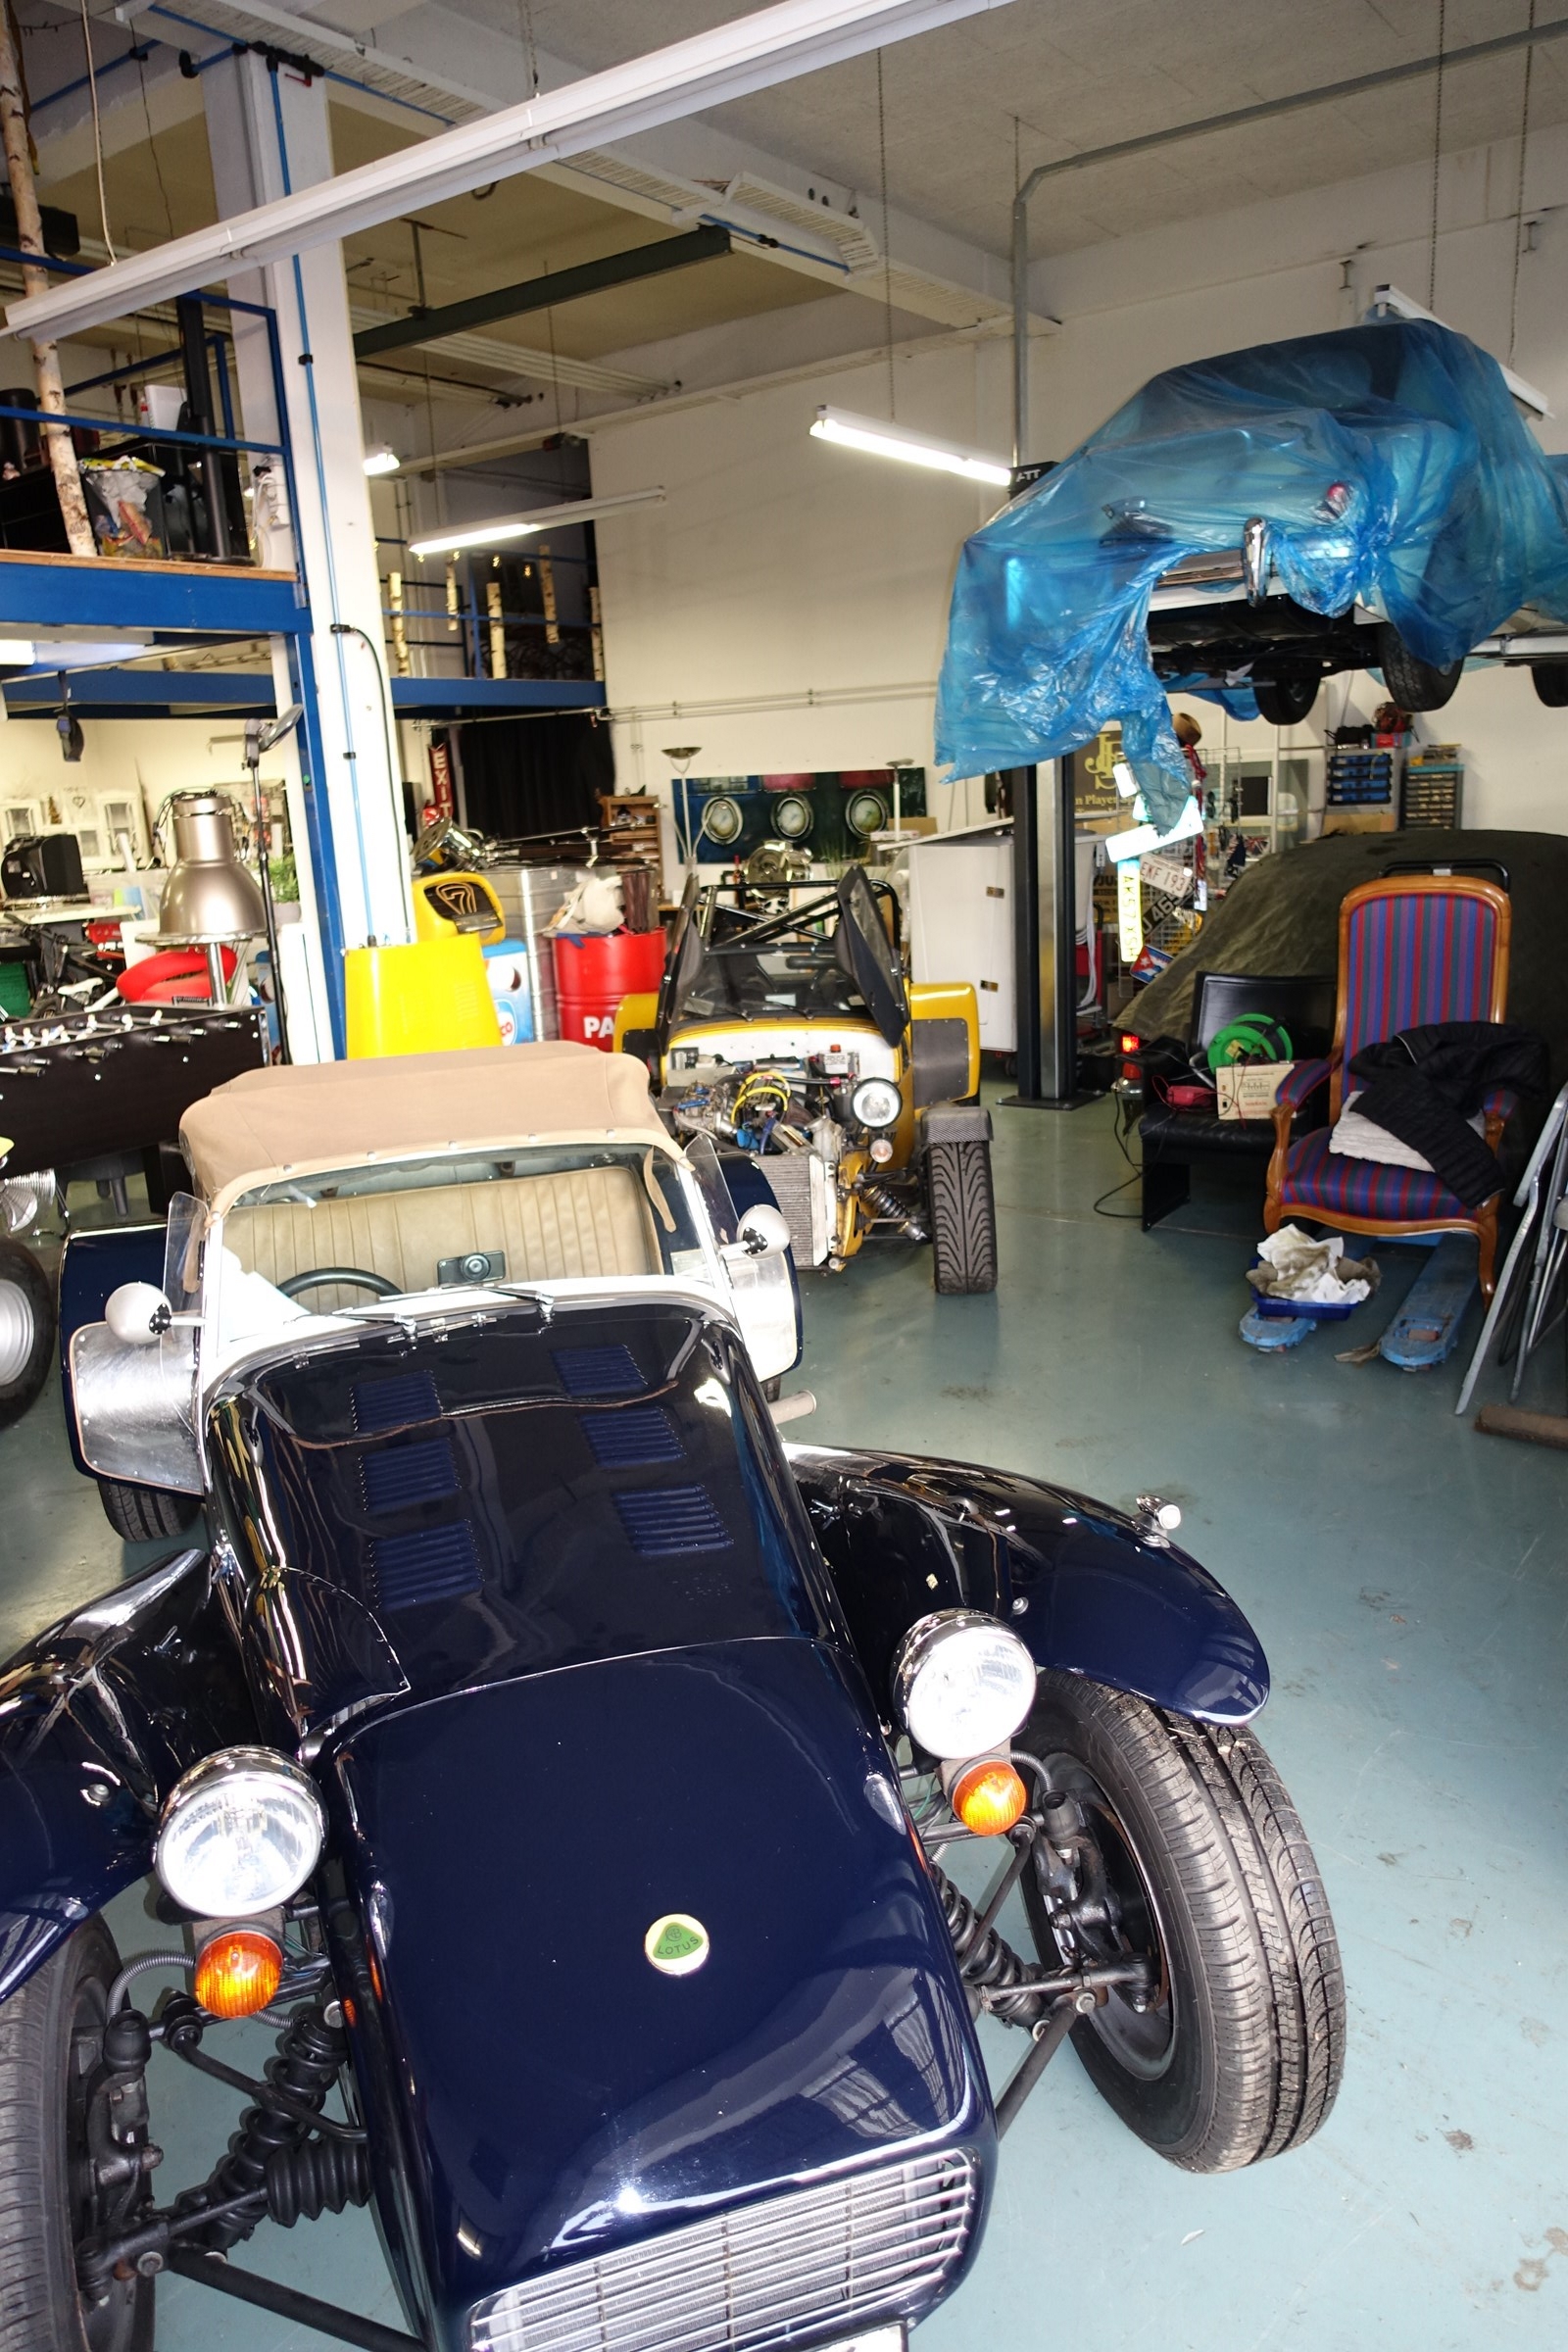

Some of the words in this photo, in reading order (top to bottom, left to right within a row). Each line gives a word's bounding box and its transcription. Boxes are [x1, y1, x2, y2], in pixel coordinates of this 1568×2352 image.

[433, 754, 452, 818] EXIT
[1163, 871, 1186, 892] 193
[657, 1936, 699, 1955] LOTUS
